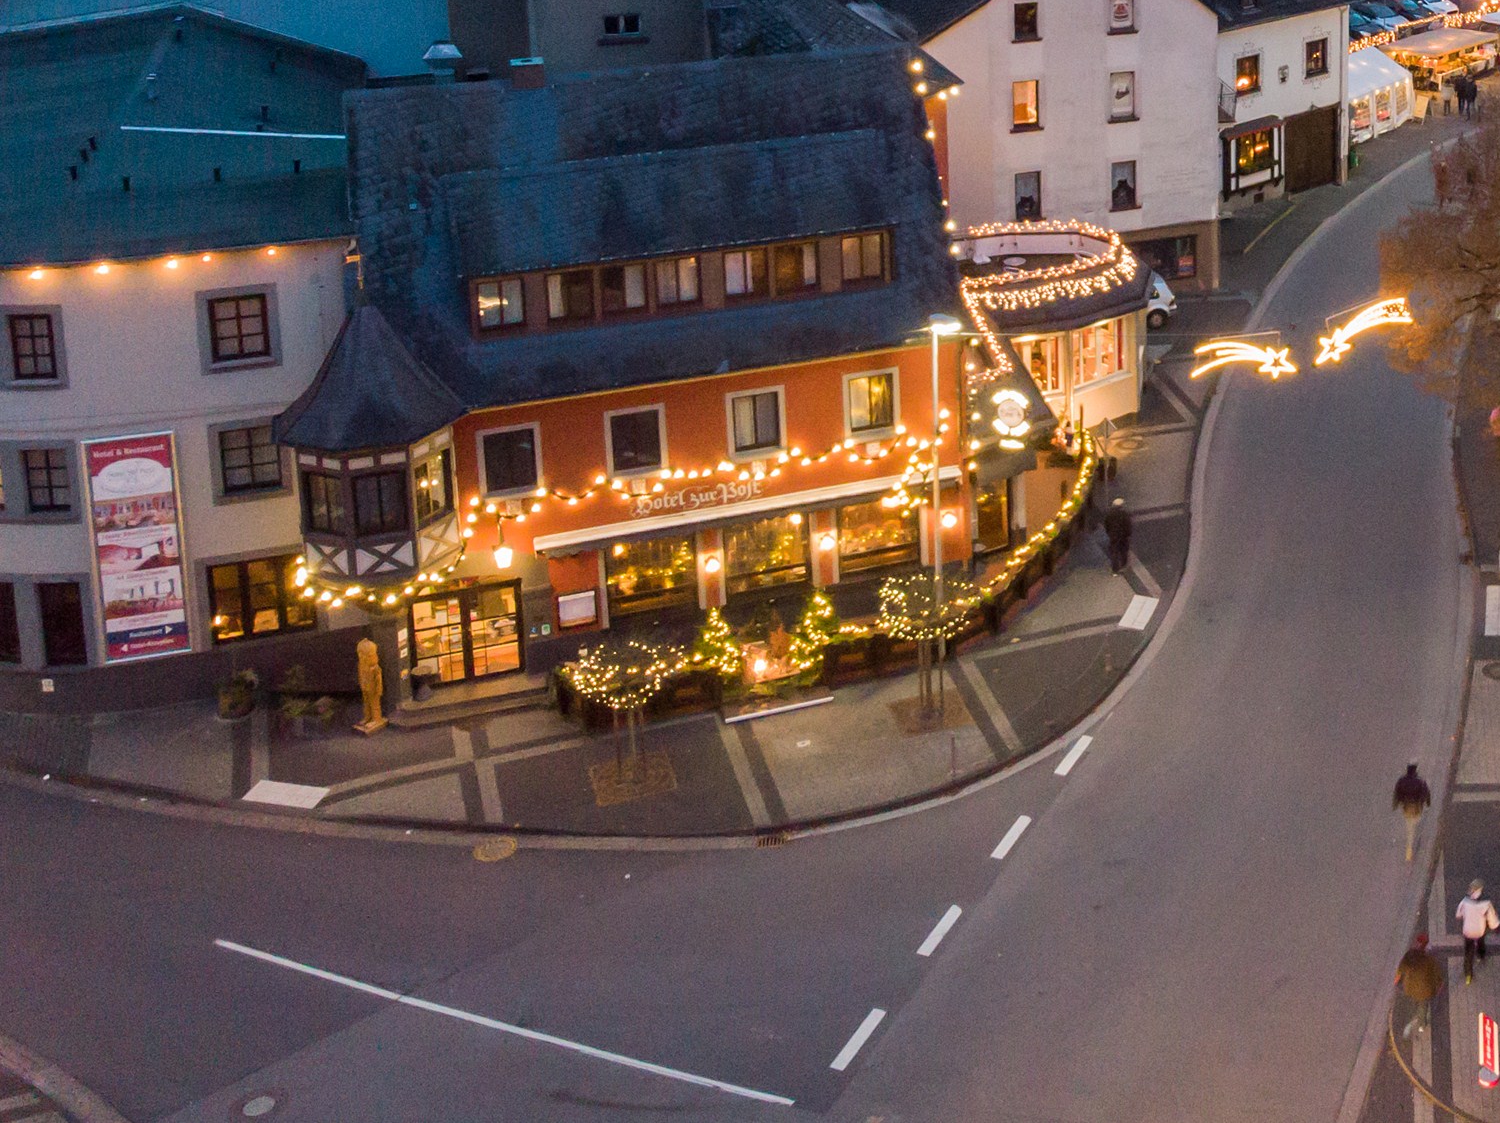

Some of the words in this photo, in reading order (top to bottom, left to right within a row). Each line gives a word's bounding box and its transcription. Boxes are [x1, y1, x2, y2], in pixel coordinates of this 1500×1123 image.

[632, 491, 686, 517] Hotel
[689, 489, 718, 509] zur
[716, 480, 762, 504] Post
